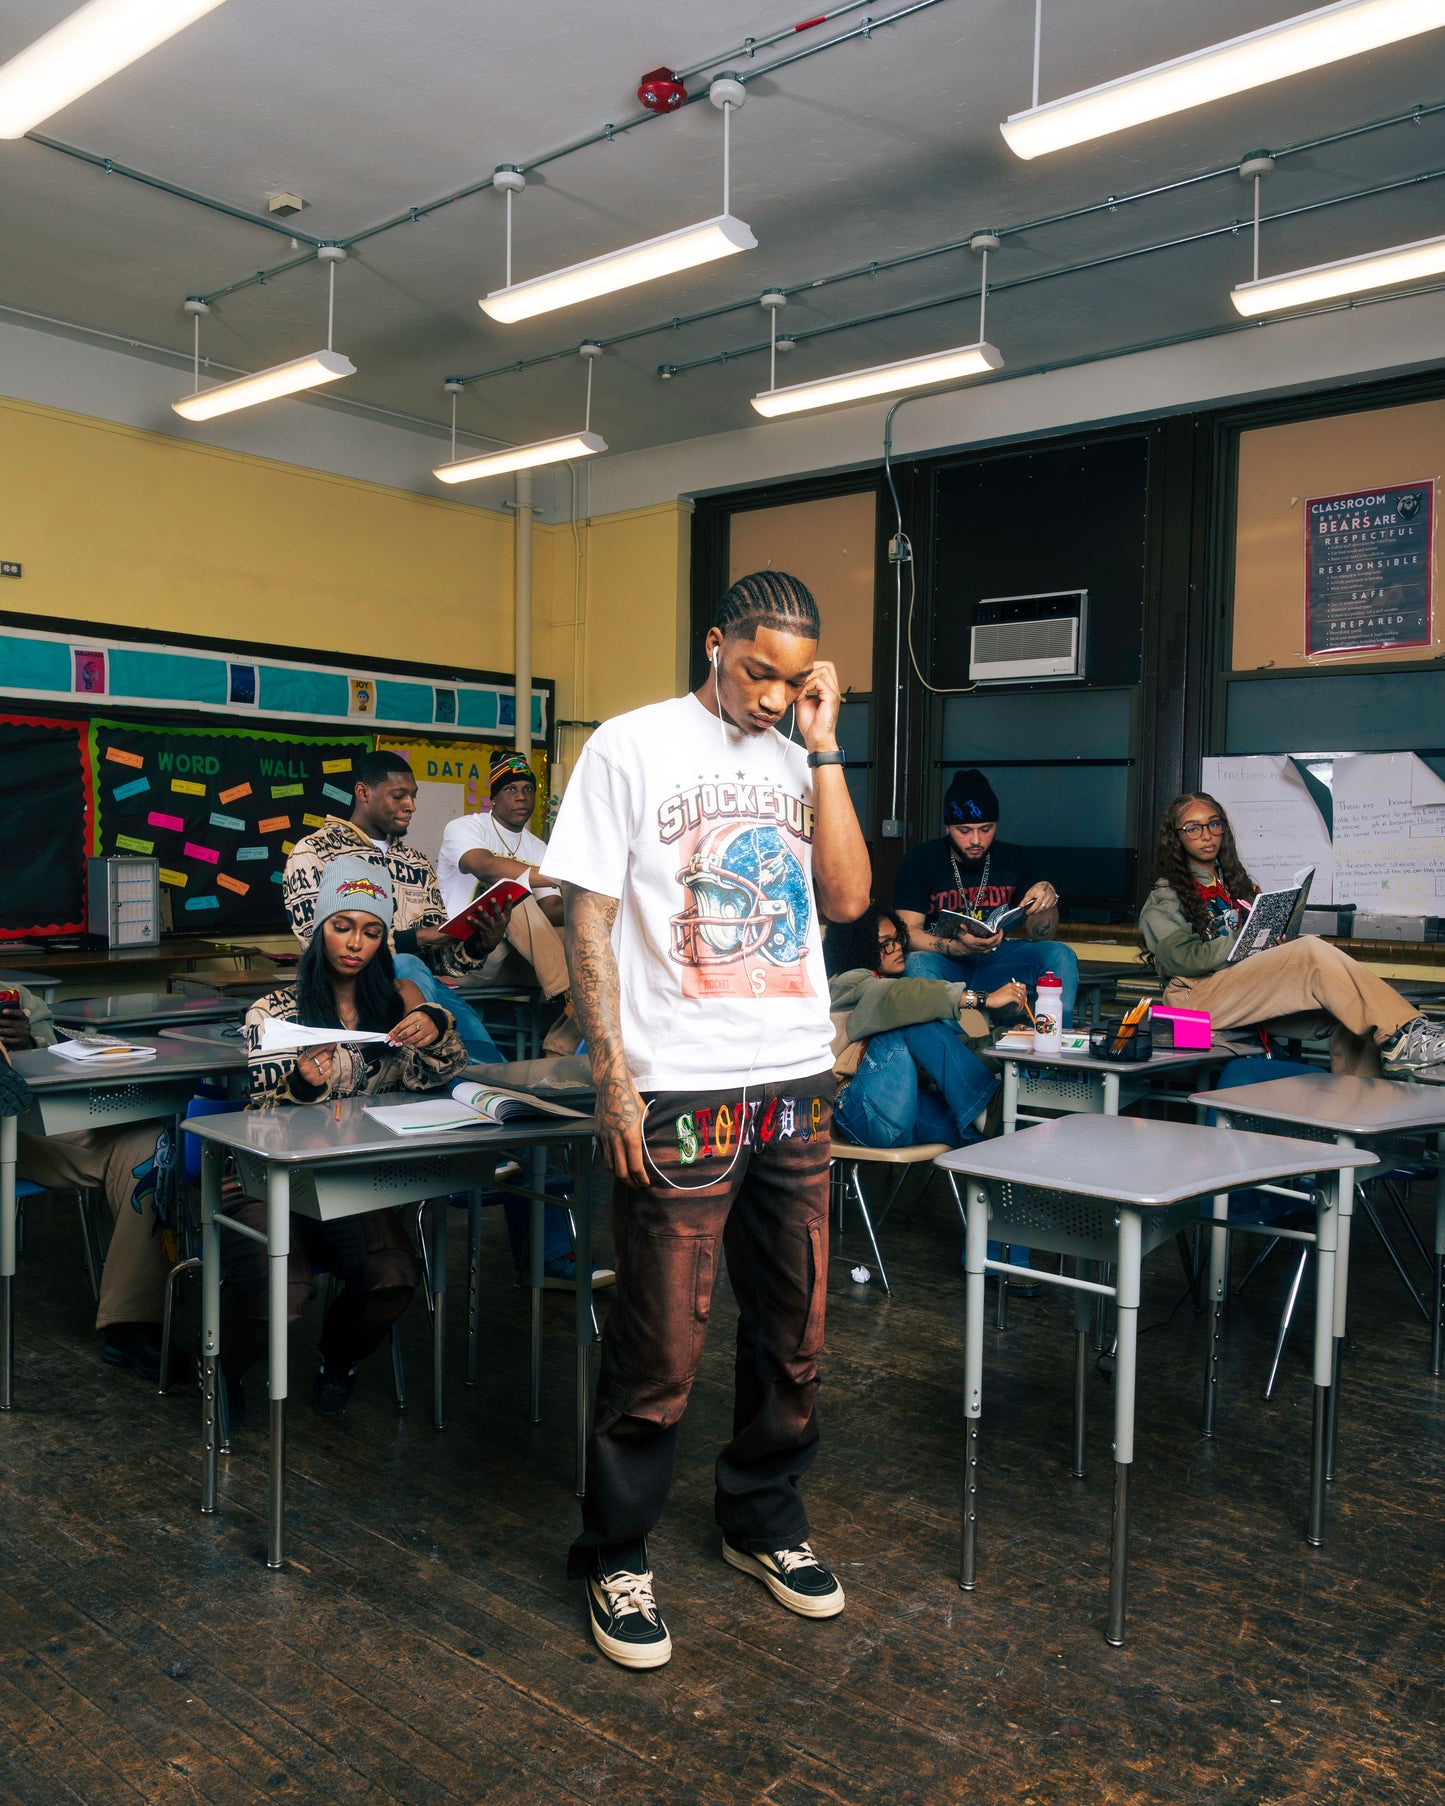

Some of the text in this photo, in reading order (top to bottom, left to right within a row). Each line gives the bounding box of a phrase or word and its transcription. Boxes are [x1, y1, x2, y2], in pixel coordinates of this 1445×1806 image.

[1311, 494, 1386, 514] CLASSROOM
[1319, 513, 1397, 534] BEARS ARE
[1320, 510, 1368, 522] BRYANT
[1325, 527, 1414, 545] RESPECTFUL
[1319, 555, 1418, 575] RESPONSIBLE
[1352, 589, 1385, 600] SAFE
[1331, 615, 1404, 630] PREPARED
[355, 680, 369, 689] JOY
[158, 752, 220, 775] WORD
[260, 758, 310, 779] WALL
[427, 760, 479, 779] DATA
[1217, 762, 1264, 781] Fractions
[1336, 800, 1360, 811] There
[750, 968, 768, 995] S
